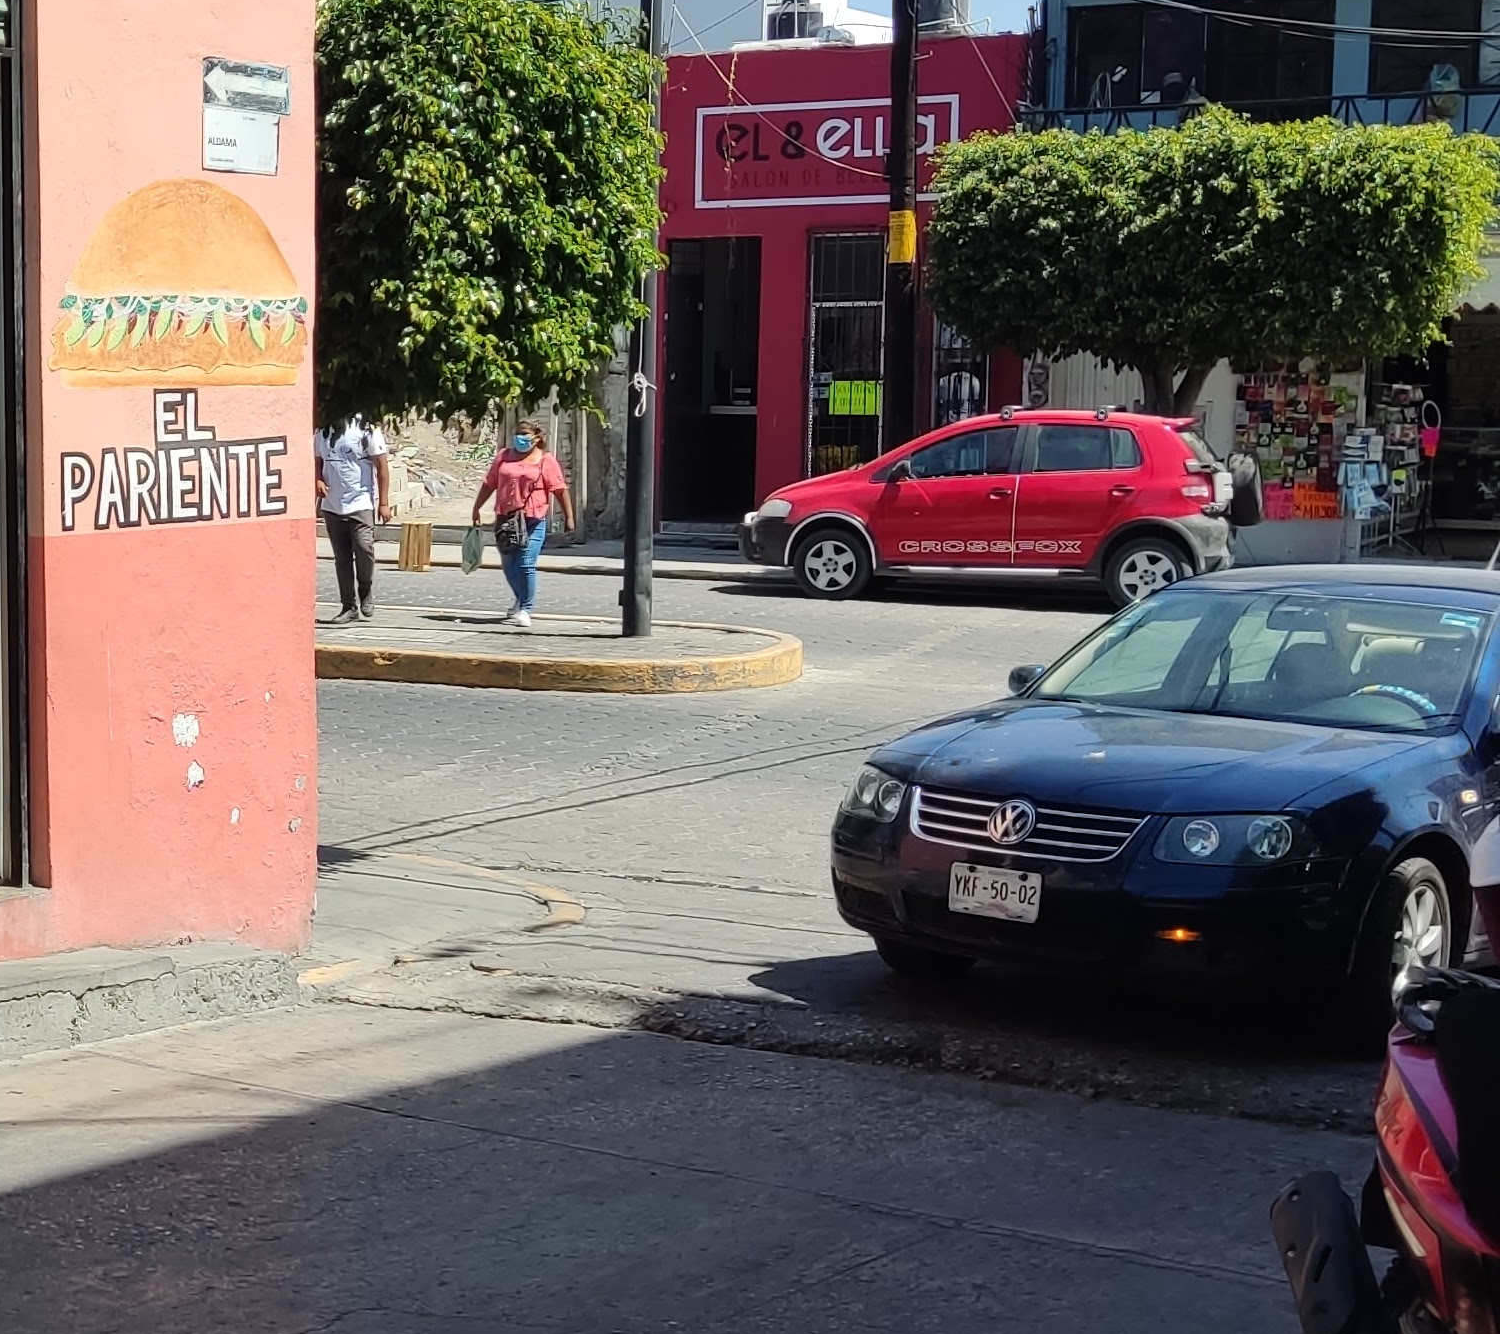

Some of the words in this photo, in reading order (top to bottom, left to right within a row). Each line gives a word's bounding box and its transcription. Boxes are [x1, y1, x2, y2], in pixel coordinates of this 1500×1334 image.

[154, 388, 216, 443] EL
[61, 436, 287, 531] PARIENTE
[898, 540, 1082, 554] CROSSFOX
